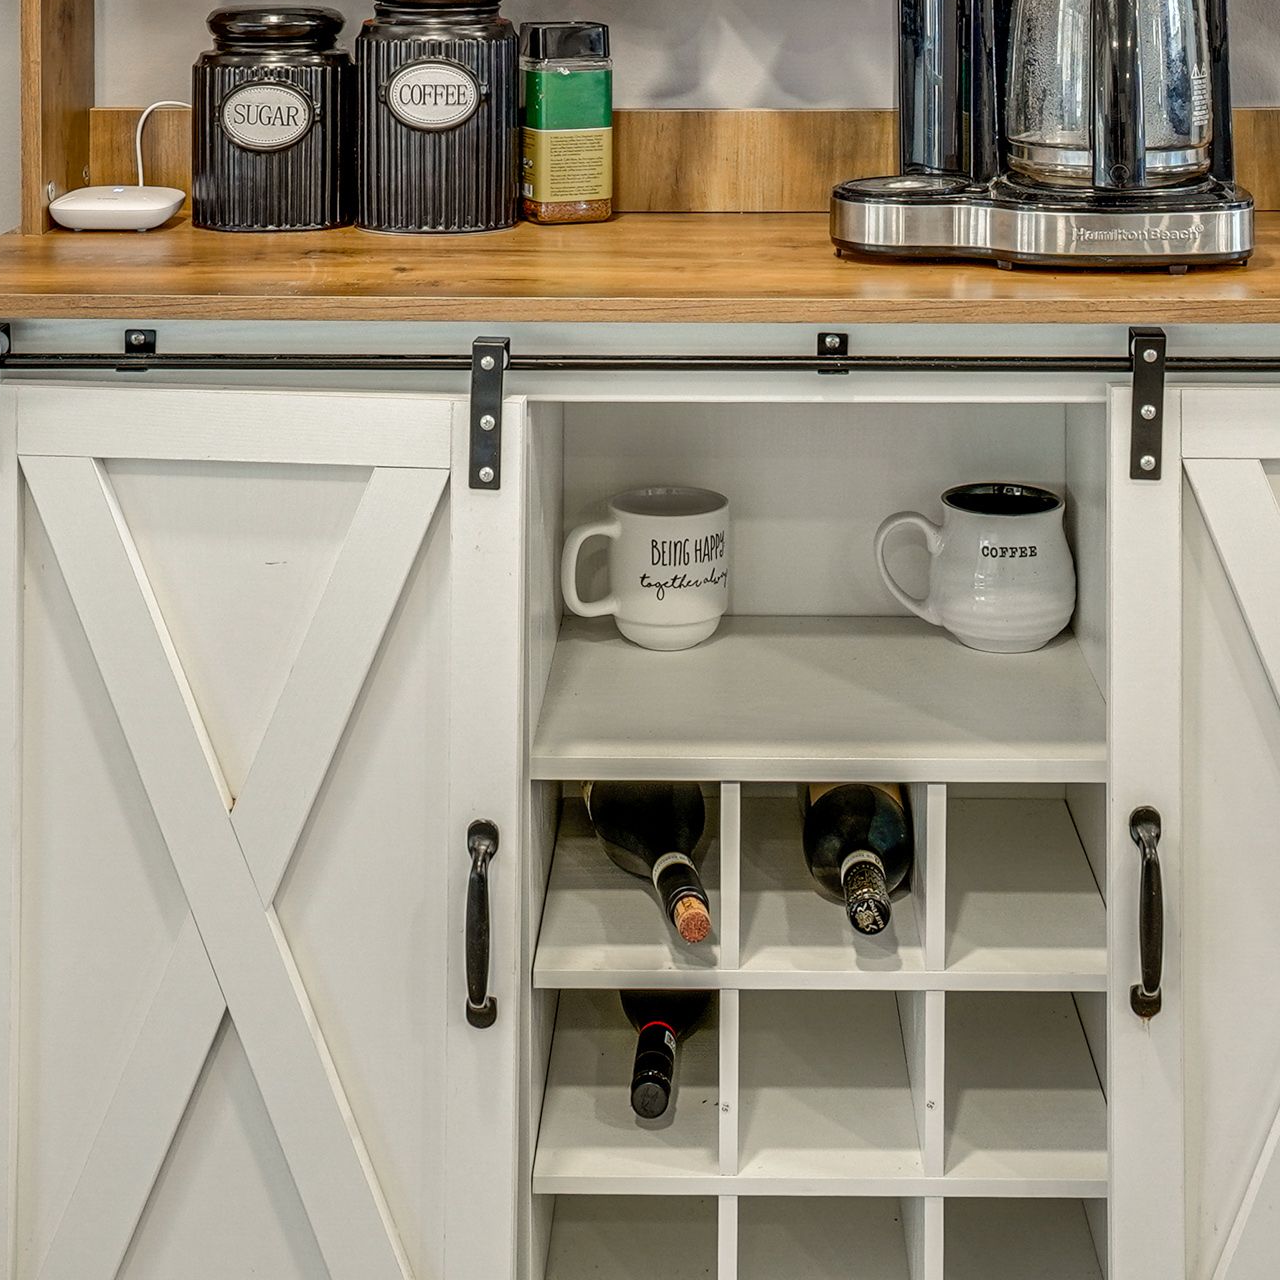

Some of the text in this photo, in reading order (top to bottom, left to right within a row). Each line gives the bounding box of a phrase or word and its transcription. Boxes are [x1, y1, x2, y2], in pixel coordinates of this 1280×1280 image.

[399, 83, 469, 106] COFFEE
[233, 103, 300, 127] SUGAR
[1071, 226, 1149, 241] Hamilton
[651, 529, 726, 567] BEING HAPPY
[981, 545, 1038, 558] COFFEE
[639, 567, 729, 601] together alway
